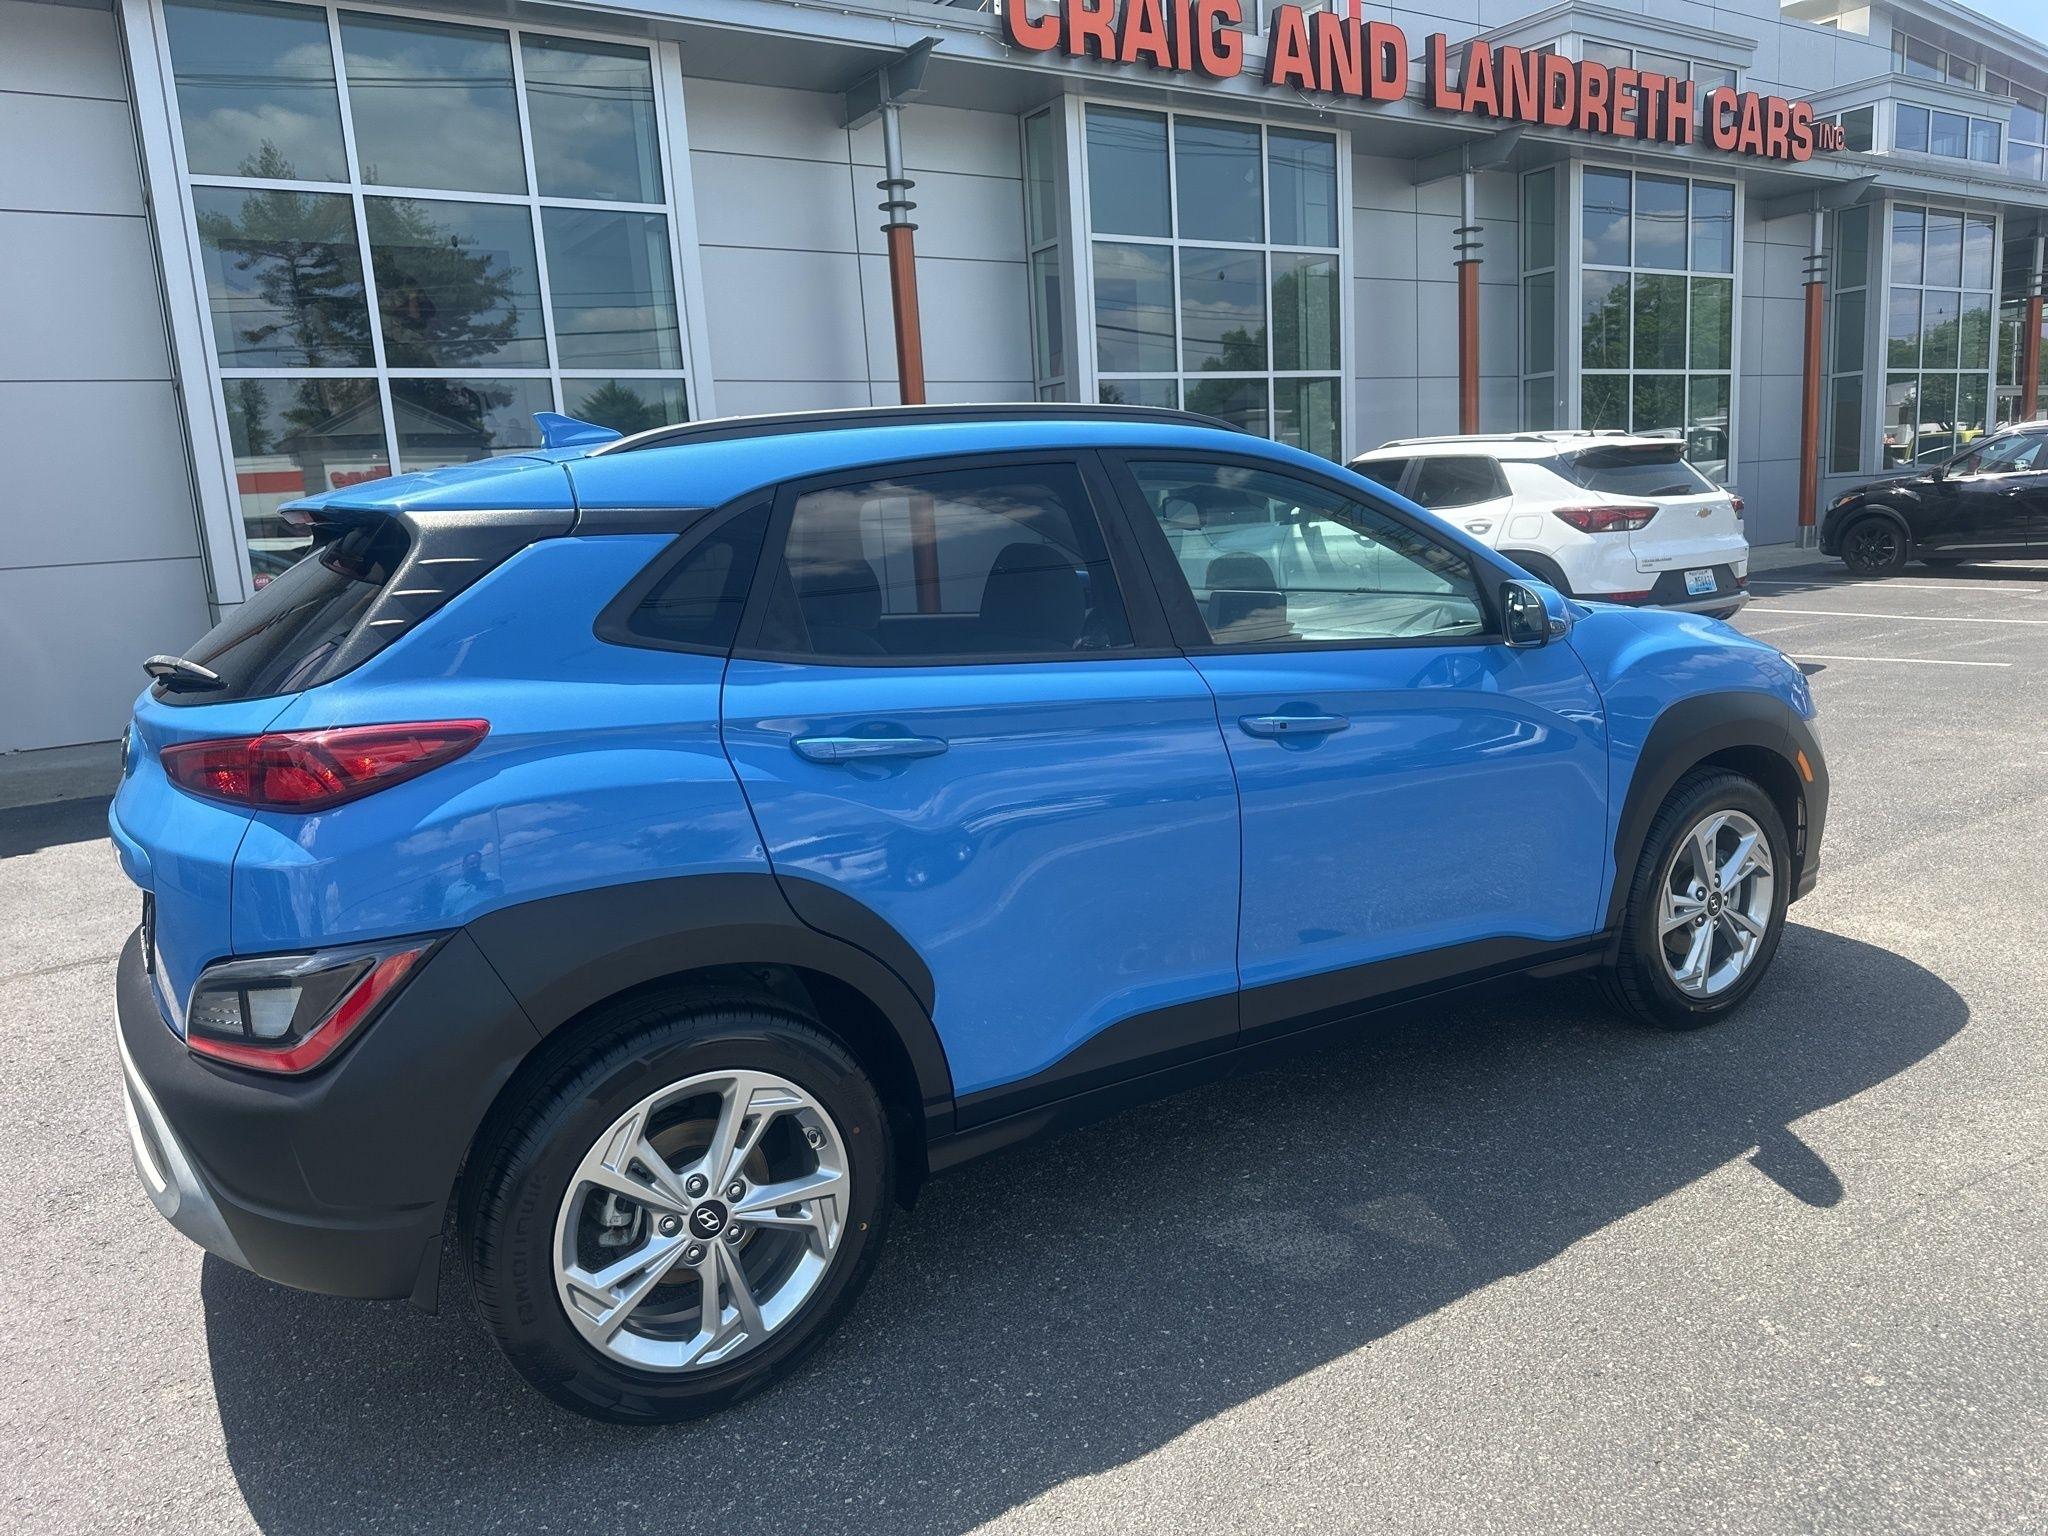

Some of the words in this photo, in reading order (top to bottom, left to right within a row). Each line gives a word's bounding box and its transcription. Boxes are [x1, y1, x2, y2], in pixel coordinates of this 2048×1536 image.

[1004, 0, 1243, 78] CRAIG
[1265, 4, 1408, 101] AND
[1426, 33, 1695, 145] LANDRETH
[1705, 86, 1814, 162] CARS
[1819, 123, 1846, 151] INC
